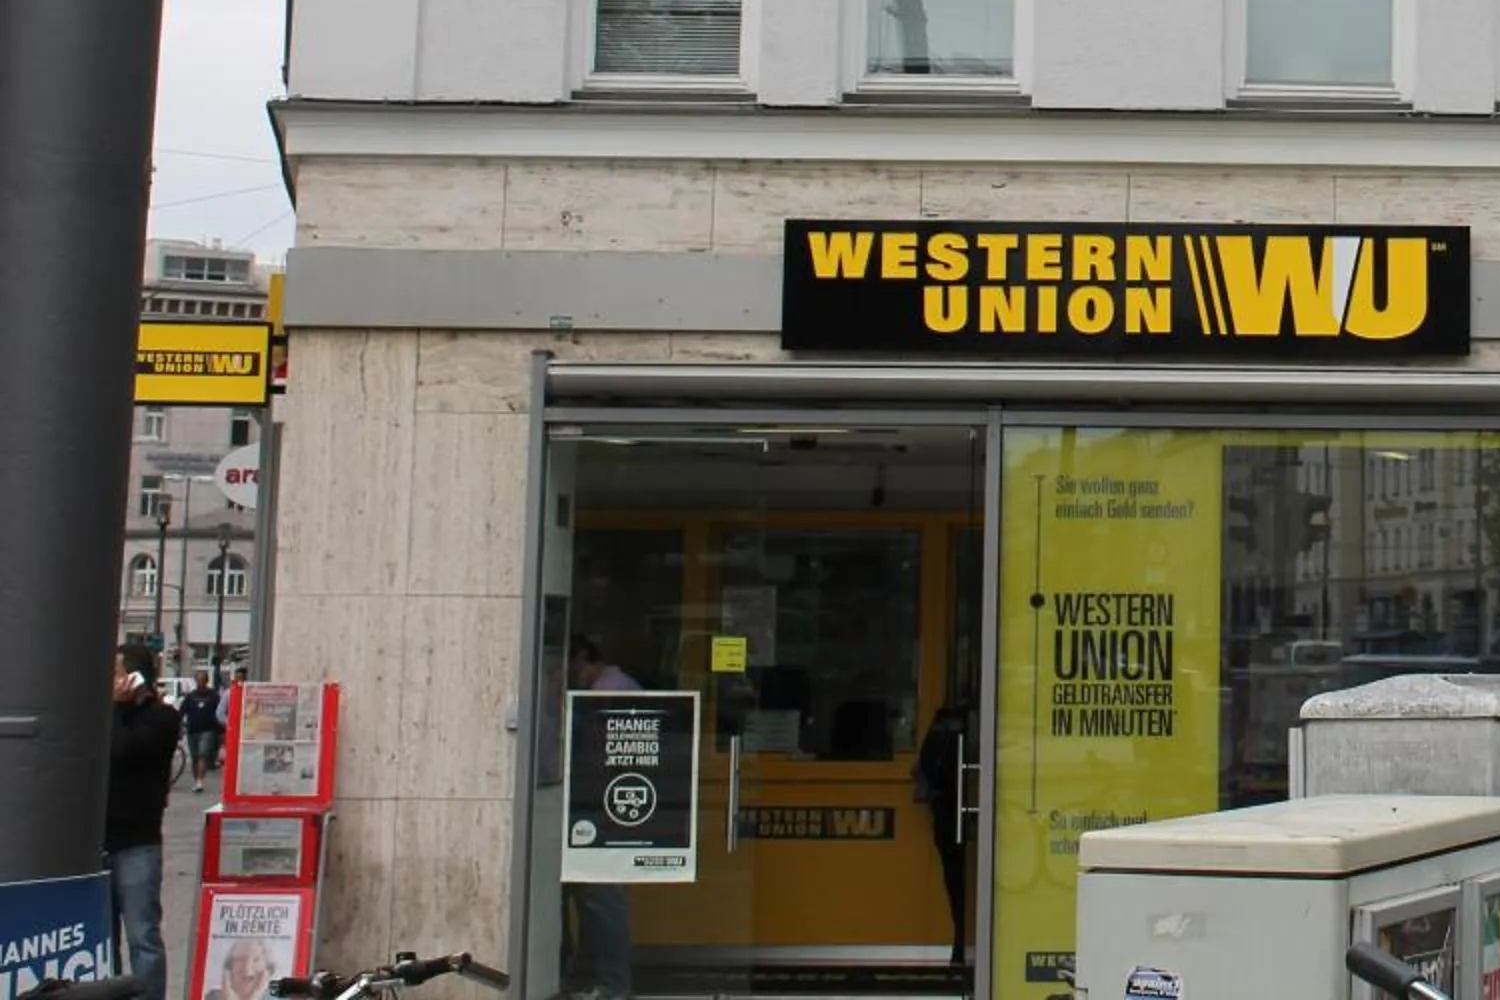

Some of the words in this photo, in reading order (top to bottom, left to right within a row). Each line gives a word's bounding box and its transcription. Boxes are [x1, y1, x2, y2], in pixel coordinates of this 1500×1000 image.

[807, 232, 1172, 281] WESTERN
[1217, 235, 1428, 340] WU
[922, 285, 1172, 333] UNION
[154, 363, 204, 373] UNION
[1054, 593, 1173, 626] WESTERN
[1054, 630, 1173, 680] UNION
[1053, 684, 1173, 705] GELDTRANSFER
[607, 719, 660, 731] CHANGE
[1052, 709, 1072, 736] IN
[605, 741, 660, 754] CAMBIO
[0, 922, 84, 966] ANNES
